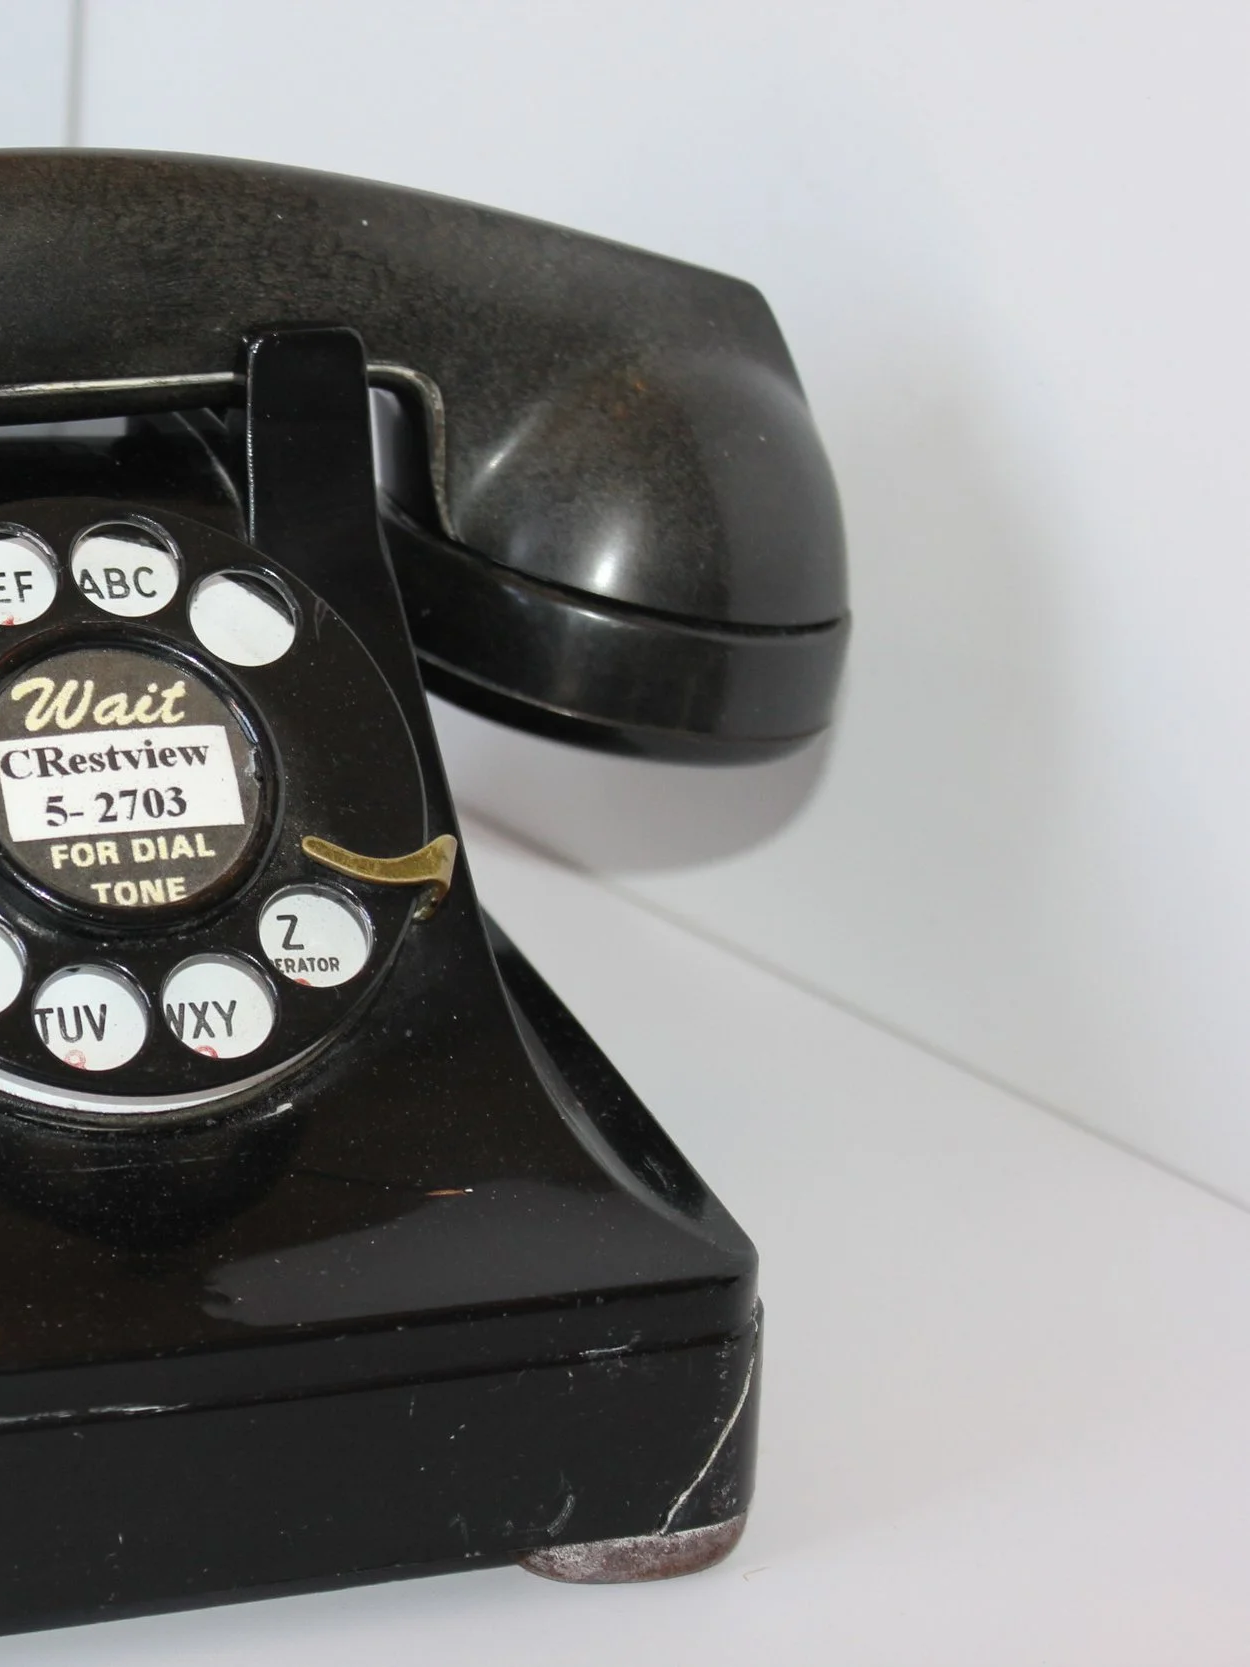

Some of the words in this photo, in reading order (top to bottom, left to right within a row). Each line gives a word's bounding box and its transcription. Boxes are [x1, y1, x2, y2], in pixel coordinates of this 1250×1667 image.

[78, 566, 158, 600] ABC
[10, 677, 187, 732] Wait
[0, 739, 210, 780] CRestview
[93, 786, 188, 824] 2703
[50, 840, 121, 870] FOR
[130, 832, 216, 863] DIAL
[90, 876, 187, 906] TONE
[276, 914, 305, 951] Z
[34, 1003, 108, 1044] TUV
